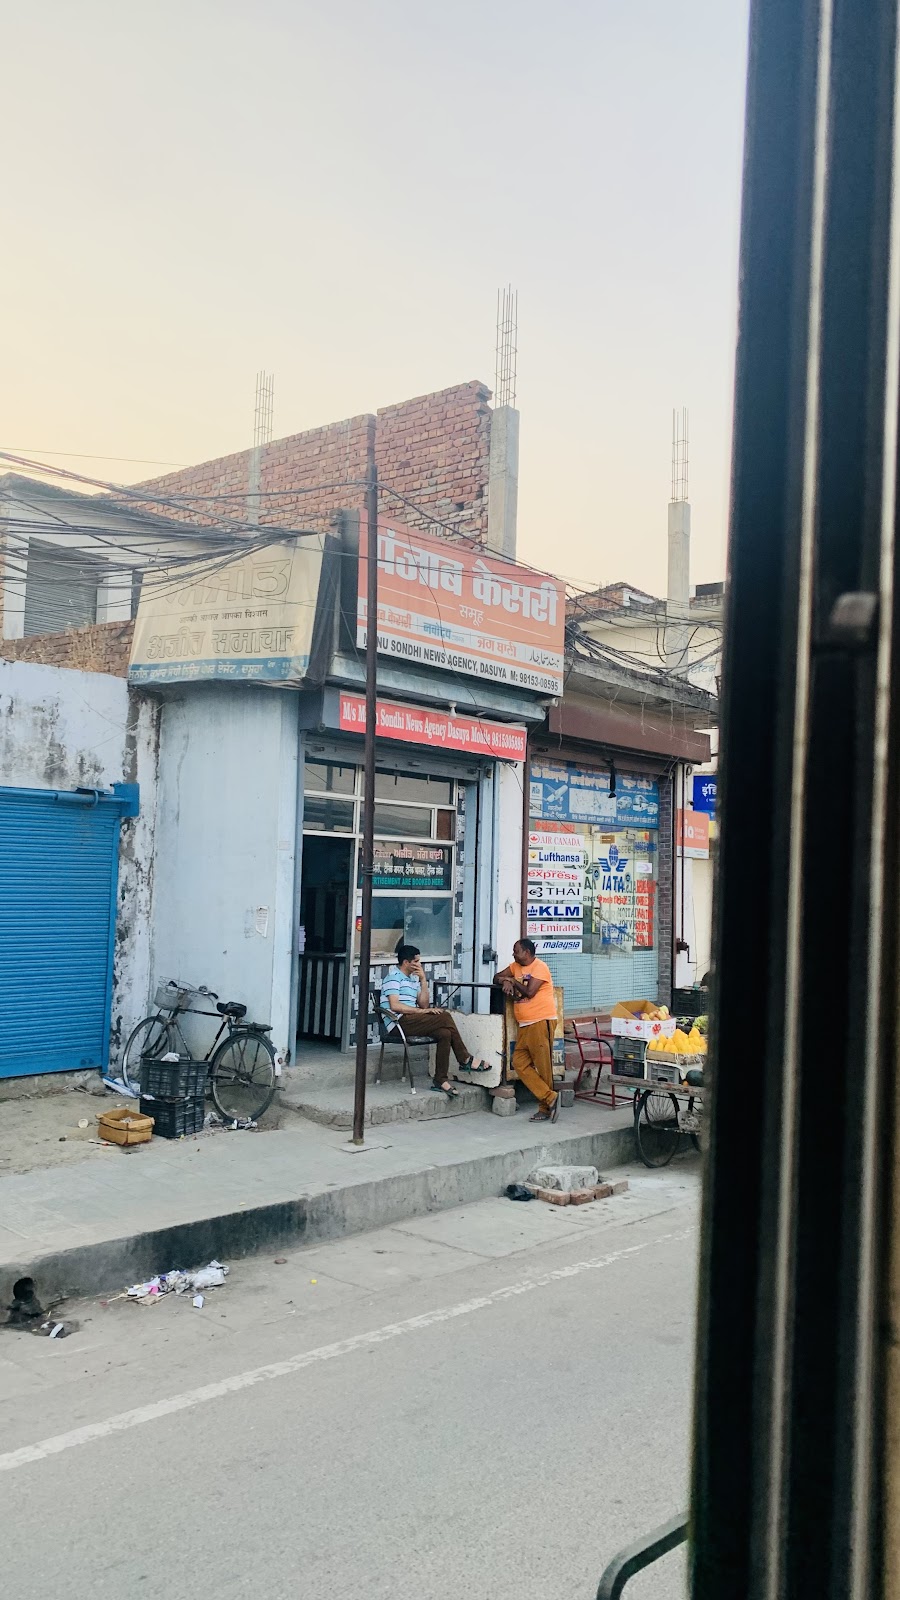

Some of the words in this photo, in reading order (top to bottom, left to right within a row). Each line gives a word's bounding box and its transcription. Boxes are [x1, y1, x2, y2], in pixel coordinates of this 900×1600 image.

[377, 529, 464, 597] पंजाब
[472, 559, 558, 626] केसरी
[459, 605, 484, 626] समूह
[146, 626, 206, 659] अजीत
[391, 640, 422, 658] SONDHI
[424, 648, 446, 663] NEWS
[447, 655, 479, 674] AGENCY,
[480, 662, 507, 679] DASUYA
[510, 670, 518, 682] M:
[519, 673, 559, 692] 98153-08595
[343, 702, 357, 722] M/s
[380, 708, 405, 731] Sondhi
[406, 713, 423, 732] News
[424, 717, 447, 741] Agency
[448, 722, 470, 744] Dasuya
[471, 726, 491, 746] Mobile
[540, 835, 553, 845] AIR
[554, 836, 581, 847] CANADA
[538, 851, 580, 863] Lufthansa
[527, 869, 578, 880] express
[545, 887, 580, 896] THAI
[539, 905, 580, 917] KLM
[539, 923, 581, 933] Emirates
[542, 940, 581, 951] malaysia
